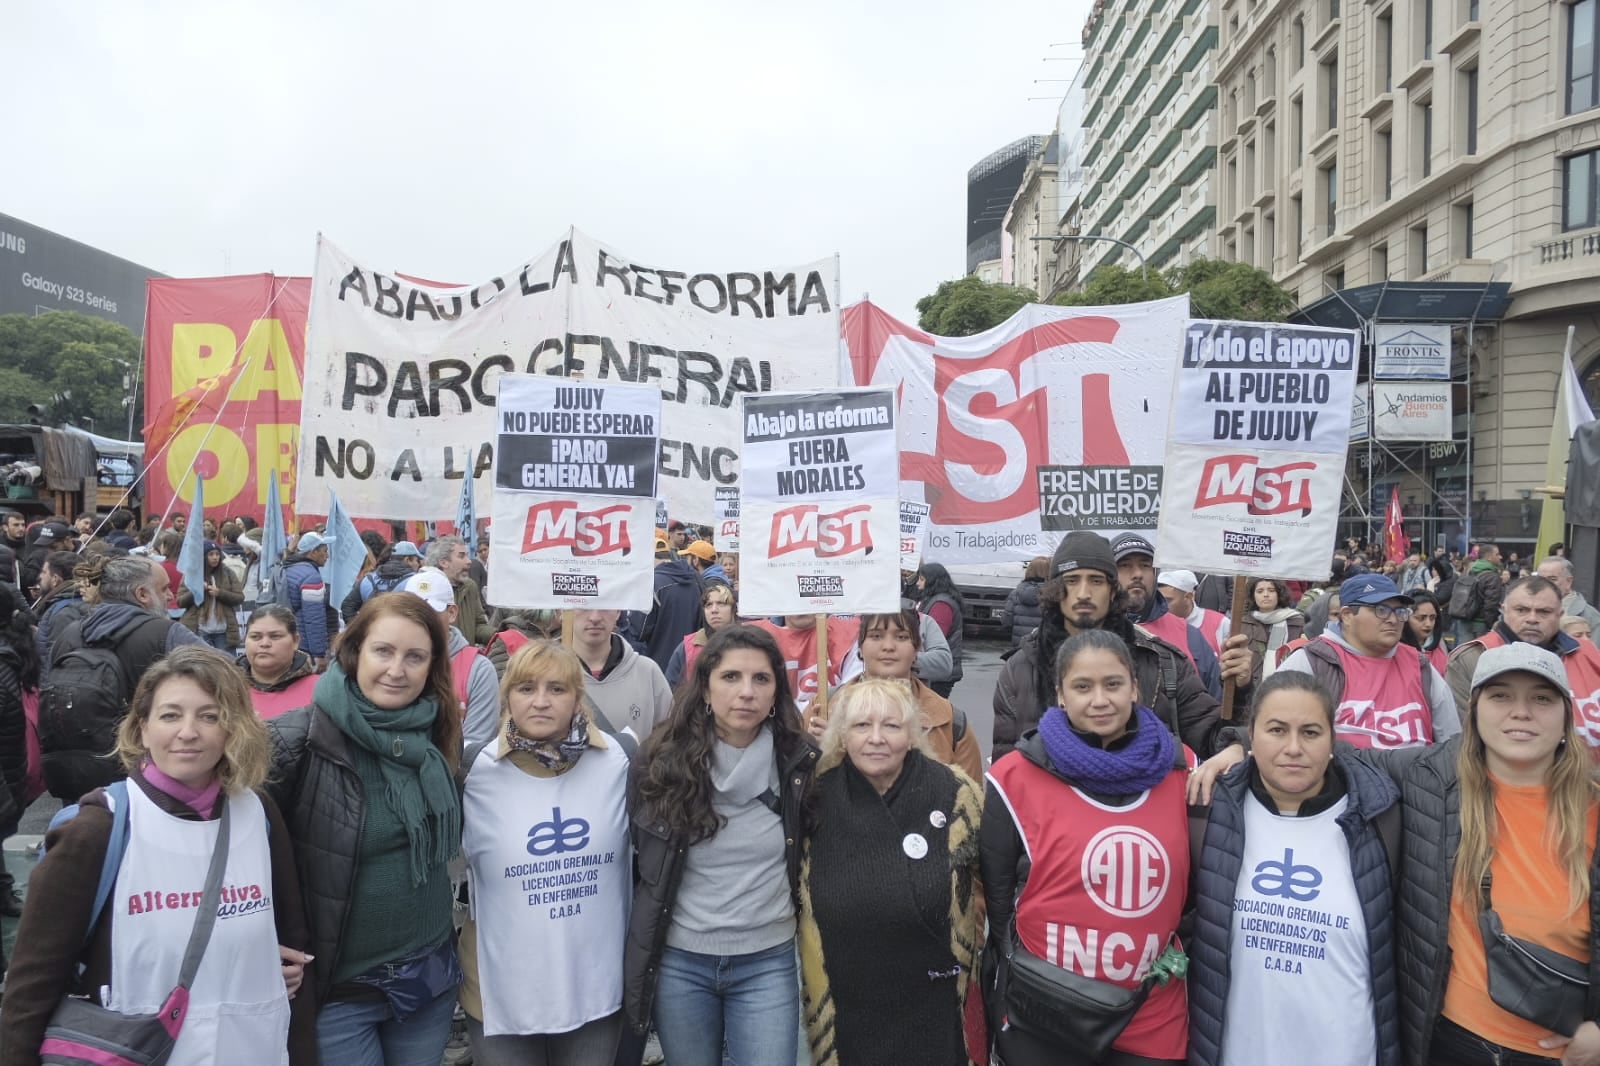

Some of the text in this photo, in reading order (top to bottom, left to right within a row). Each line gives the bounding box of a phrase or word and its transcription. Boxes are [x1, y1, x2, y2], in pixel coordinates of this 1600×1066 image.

[519, 240, 578, 297] LA
[596, 249, 831, 318] REFORMA
[22, 272, 118, 313] Galaxy S23 Series
[1188, 330, 1351, 369] Todo el apoyo
[1385, 346, 1441, 357] FRONTIS
[341, 352, 515, 418] PARO
[1205, 372, 1330, 405] AL PUEBLO
[553, 387, 605, 410] JUJUY
[1396, 393, 1448, 403] Andamios
[1405, 402, 1445, 411] Buenos
[503, 411, 654, 436] NO PUEDE ESPERAR
[746, 404, 889, 438] Abajo la reforma
[1213, 410, 1318, 442] DE JUJUY
[1402, 410, 1428, 418] Aires
[315, 435, 494, 482] NO A LA
[551, 438, 608, 464] ¡PARO
[788, 436, 850, 467] FUERA
[1430, 442, 1458, 459] BBVA
[521, 463, 636, 489] GENERAL YA!
[776, 463, 866, 496] MORALES
[1039, 469, 1159, 493] FRENTE DE
[1203, 461, 1316, 511] MST
[1040, 492, 1162, 517] IZQUIERDA
[529, 506, 630, 553] MST
[775, 508, 873, 553] MST
[1078, 517, 1086, 526] Y
[1087, 517, 1100, 526] DE
[929, 530, 1038, 552] los Trabajadores
[1224, 541, 1271, 554] IZQUIERDA
[1225, 533, 1270, 545] FRENTE DE
[553, 574, 585, 584] FRENTE
[553, 582, 598, 592] IZQUIERDA
[799, 577, 841, 586] FRENTE DE
[799, 584, 842, 593] IZQUIERDA
[504, 851, 615, 879] ASOCIACION GREMIAL DE
[1091, 834, 1160, 909] ATE
[522, 869, 599, 891] LICENCIADAS/OS
[128, 884, 263, 916] Alterntiva
[528, 884, 598, 906] EN ENFERMERIA
[549, 903, 582, 920] C.A.B.A
[1287, 906, 1333, 927] GREMIAL
[1335, 915, 1350, 930] DE
[1240, 917, 1327, 943] LICENCIADAS/OS
[1245, 935, 1325, 960] EN ENFERMERIA
[1264, 956, 1303, 975] C.A.B.A
